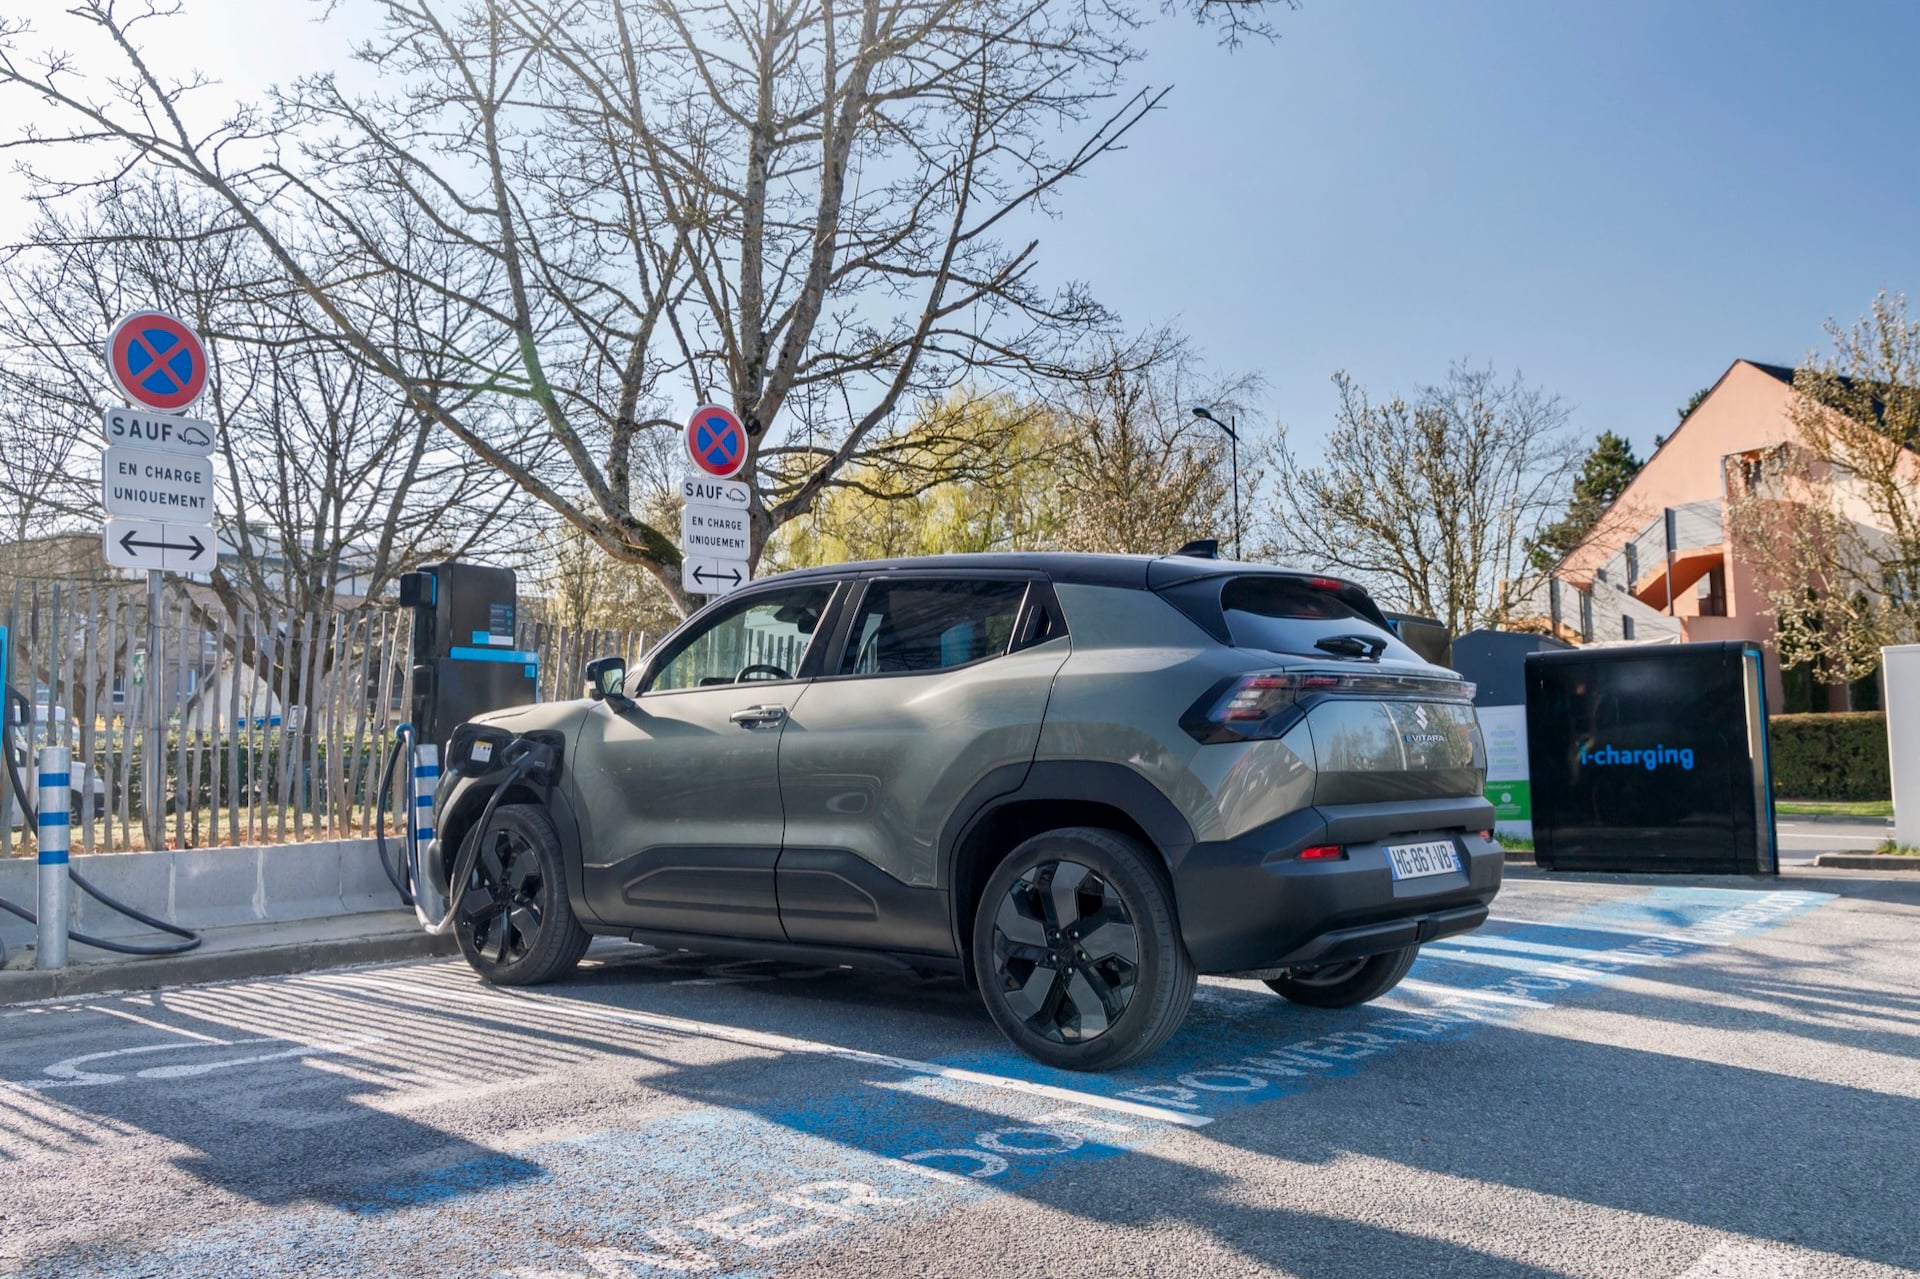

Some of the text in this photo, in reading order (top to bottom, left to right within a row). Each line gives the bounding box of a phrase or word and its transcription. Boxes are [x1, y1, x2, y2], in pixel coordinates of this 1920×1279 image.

[112, 416, 173, 442] SAUF
[119, 461, 202, 484] EN CHARGE
[114, 486, 206, 509] UNIQUEMENT
[685, 482, 723, 500] SAUF
[692, 515, 742, 531] EN CHARGE
[689, 534, 745, 549] UNIQUEMENT
[1580, 744, 1694, 771] i-charging
[1391, 844, 1453, 876] HG-861-VB
[1115, 1031, 1408, 1110] POWER
